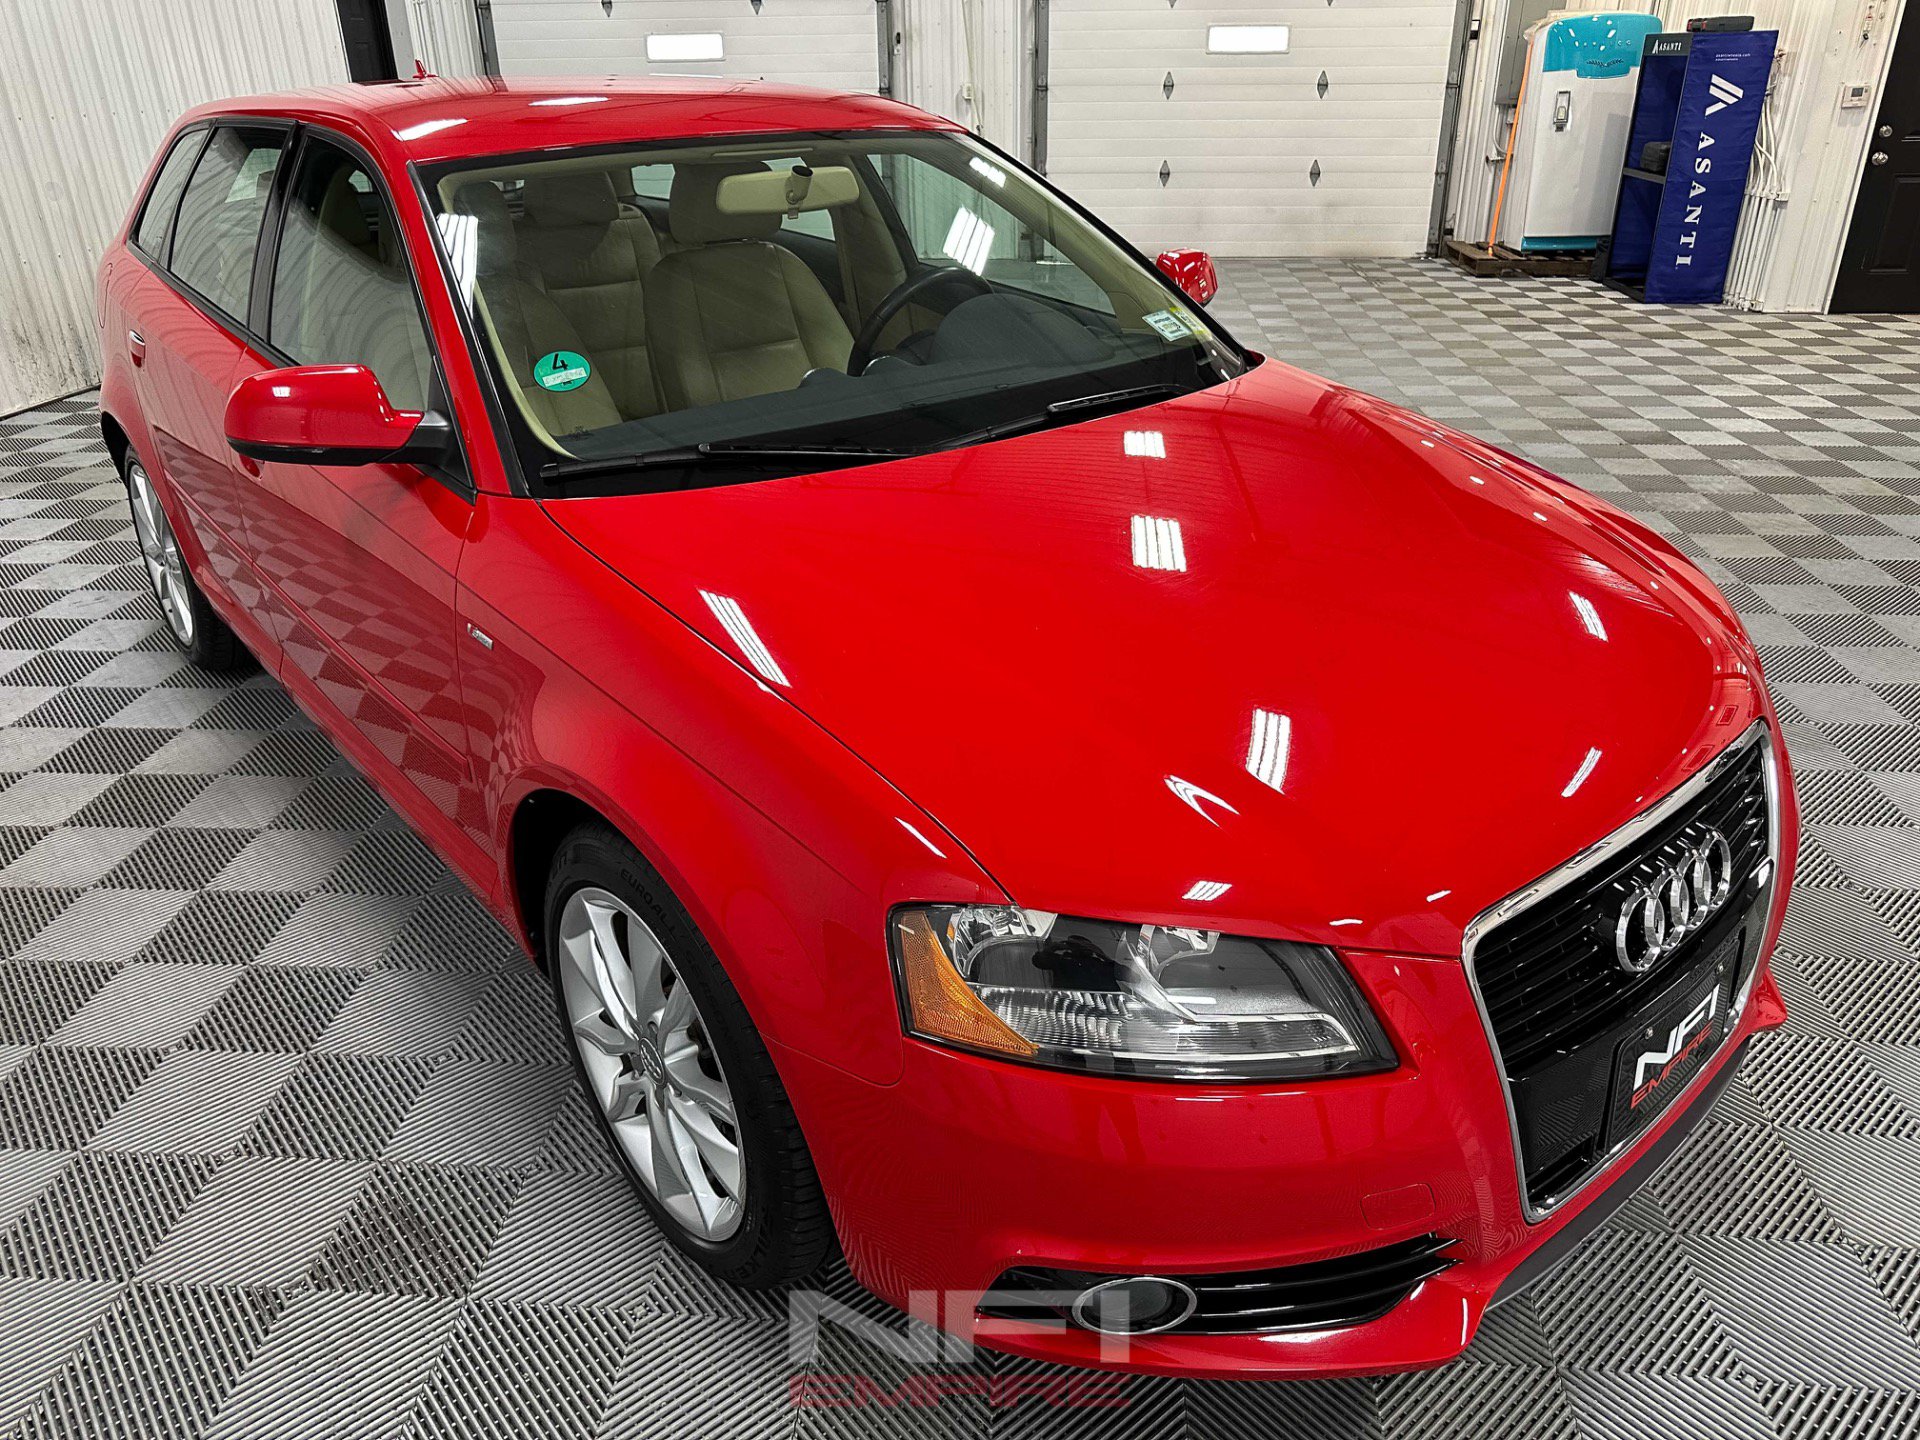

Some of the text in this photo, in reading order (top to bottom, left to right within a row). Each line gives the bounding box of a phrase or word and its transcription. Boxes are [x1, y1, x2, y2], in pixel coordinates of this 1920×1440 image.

[1675, 131, 1716, 267] ASANTI
[552, 353, 568, 370] 4
[1630, 1020, 1714, 1110] EMPIRE
[1632, 983, 1720, 1092] NFI
